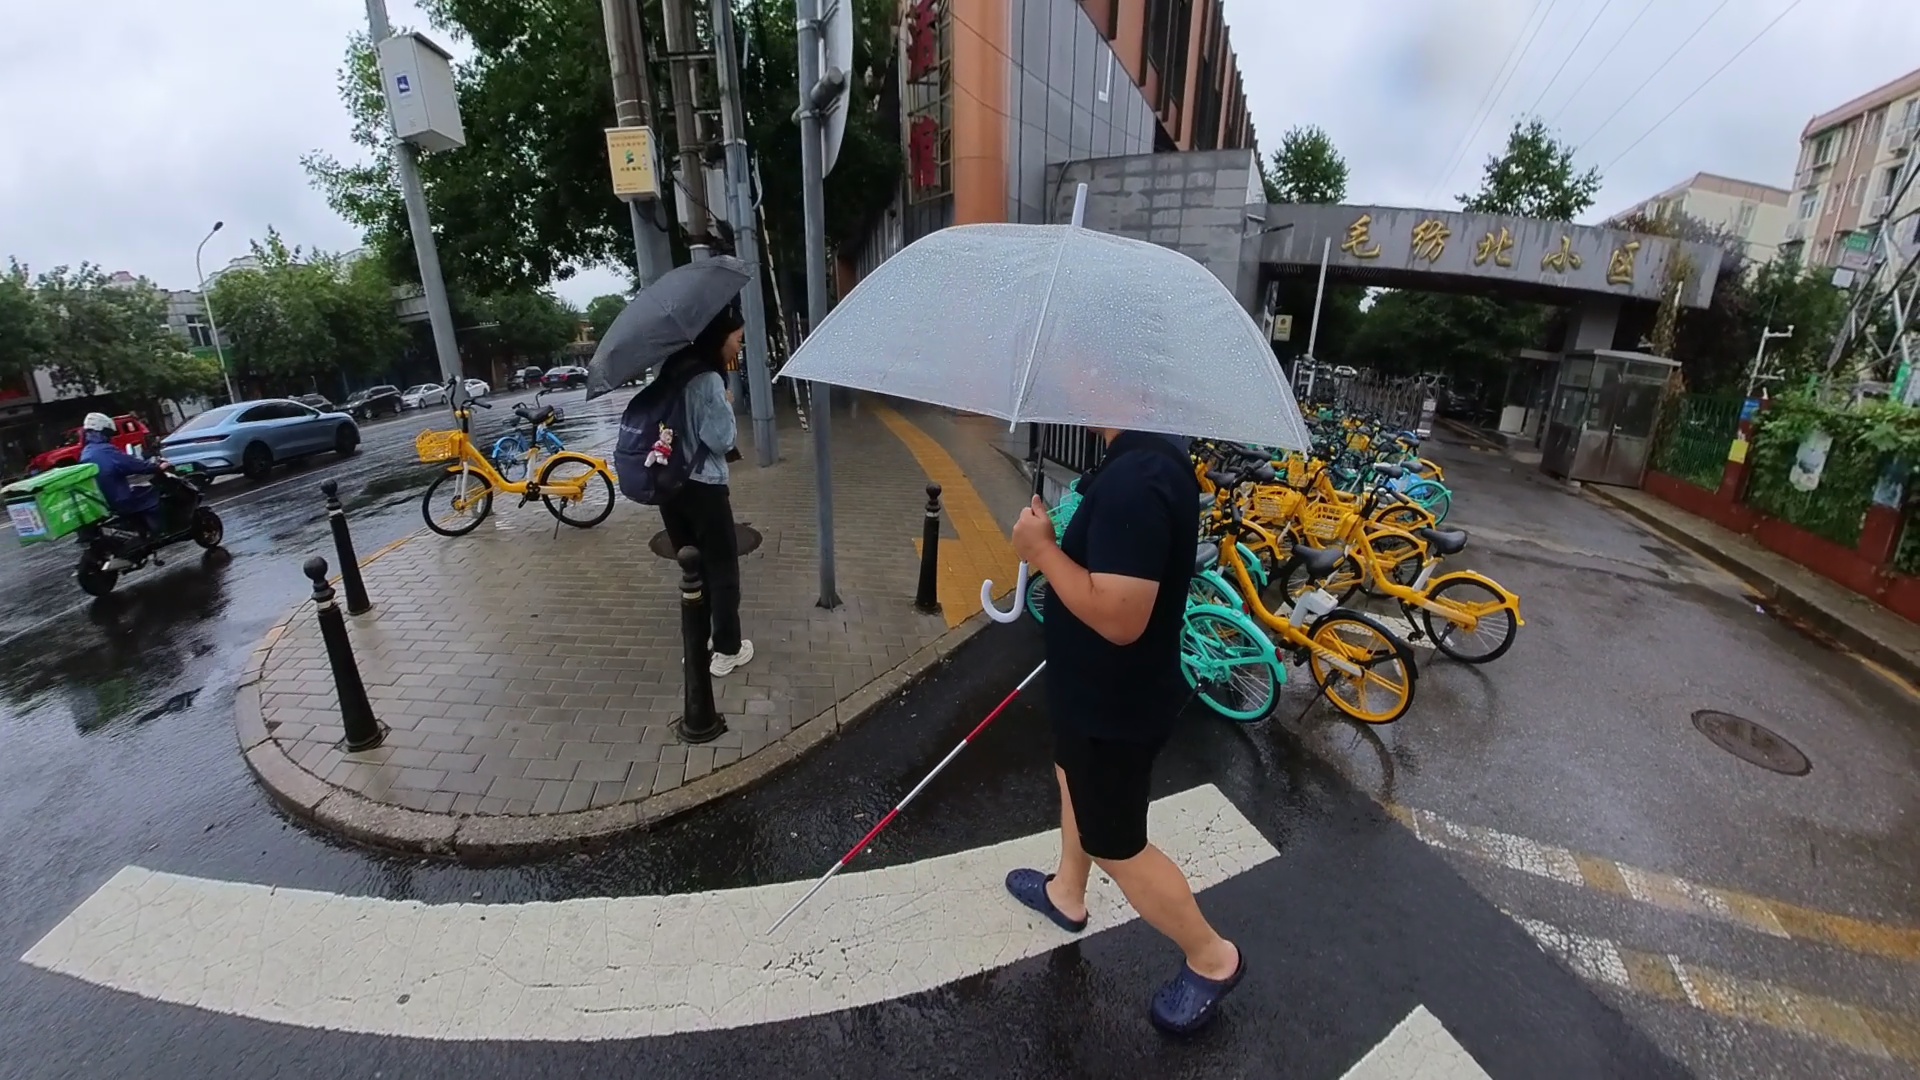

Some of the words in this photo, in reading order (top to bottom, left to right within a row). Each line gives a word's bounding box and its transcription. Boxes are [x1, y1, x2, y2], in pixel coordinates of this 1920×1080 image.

[1341, 213, 1640, 286] 毛纺北小区
